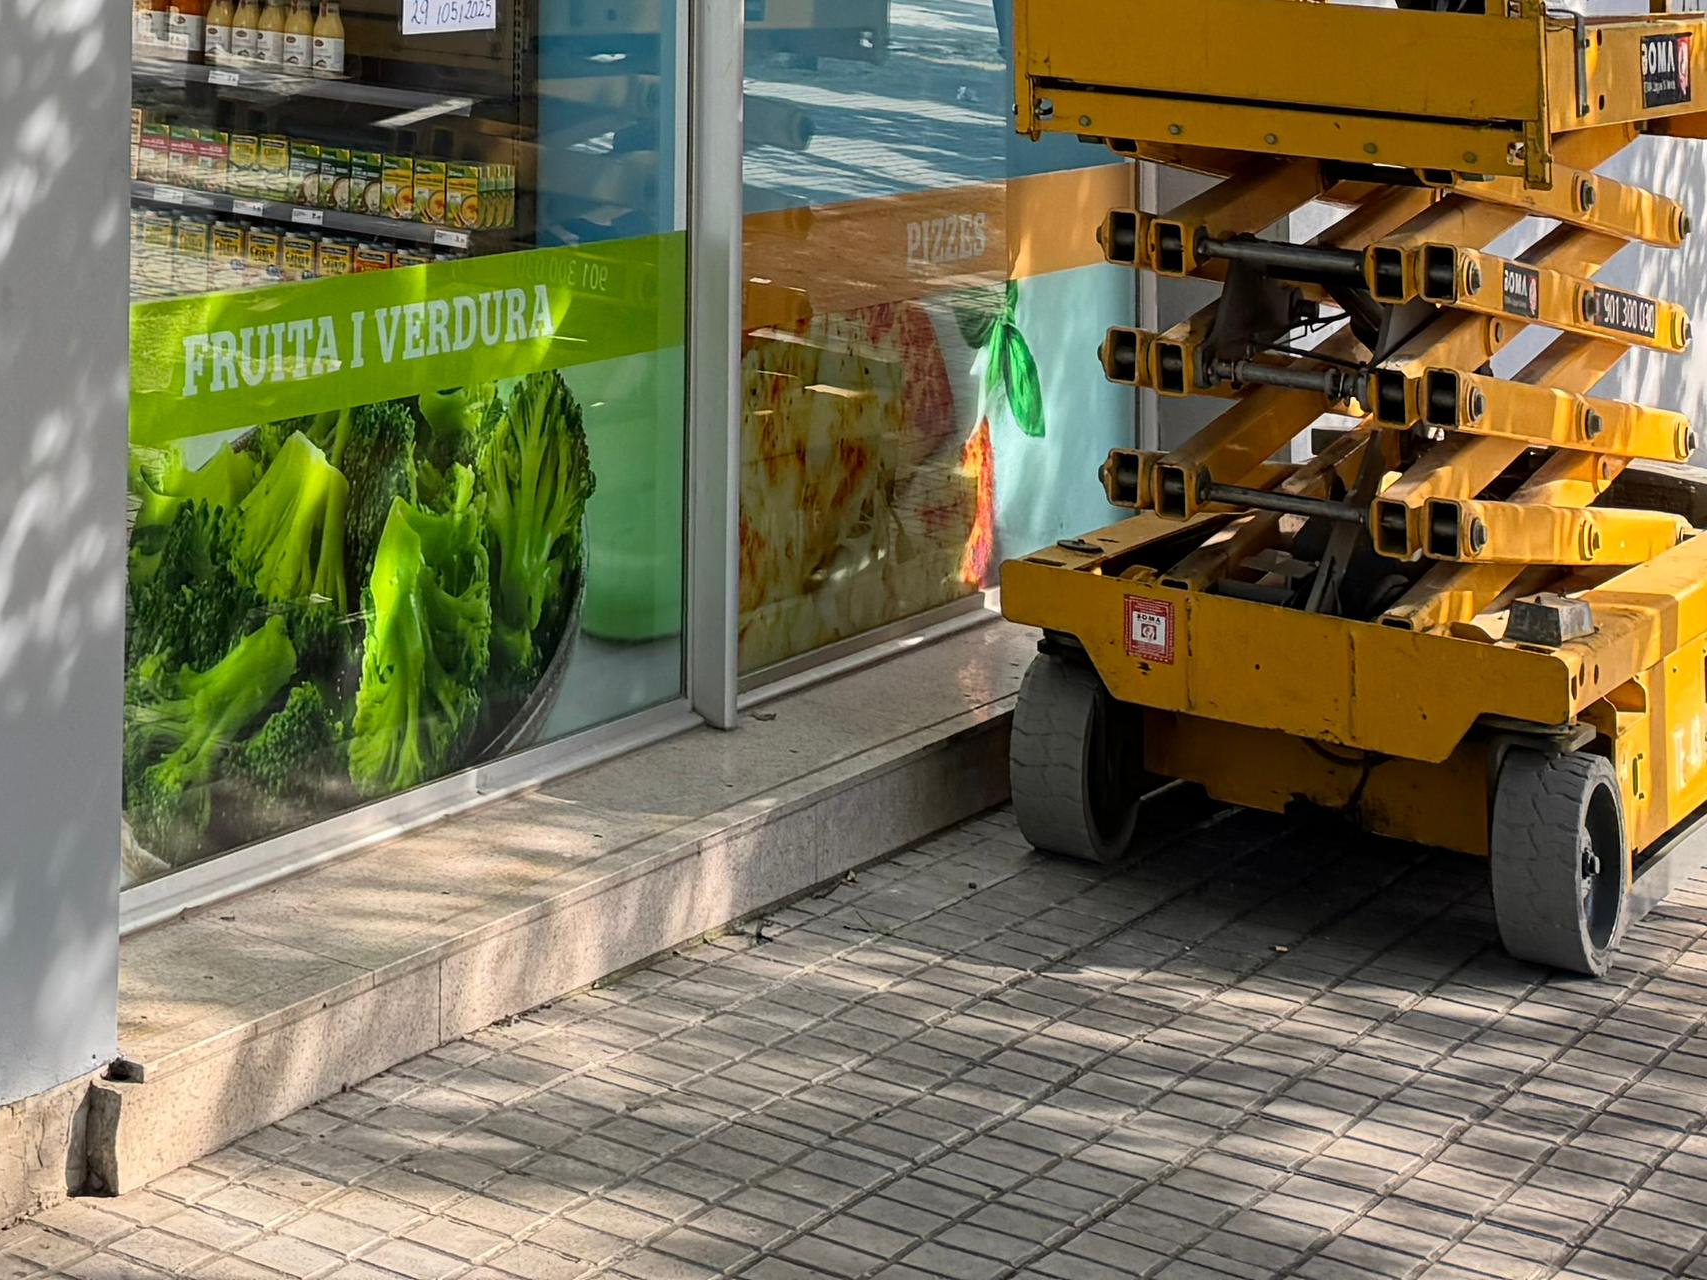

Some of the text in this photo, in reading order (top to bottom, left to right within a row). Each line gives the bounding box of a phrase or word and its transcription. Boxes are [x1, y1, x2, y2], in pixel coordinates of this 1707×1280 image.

[906, 212, 988, 267] PIZZES
[1603, 293, 1621, 324] 901
[1621, 297, 1638, 329] 300
[181, 284, 554, 397] FRUITA I VERDURA
